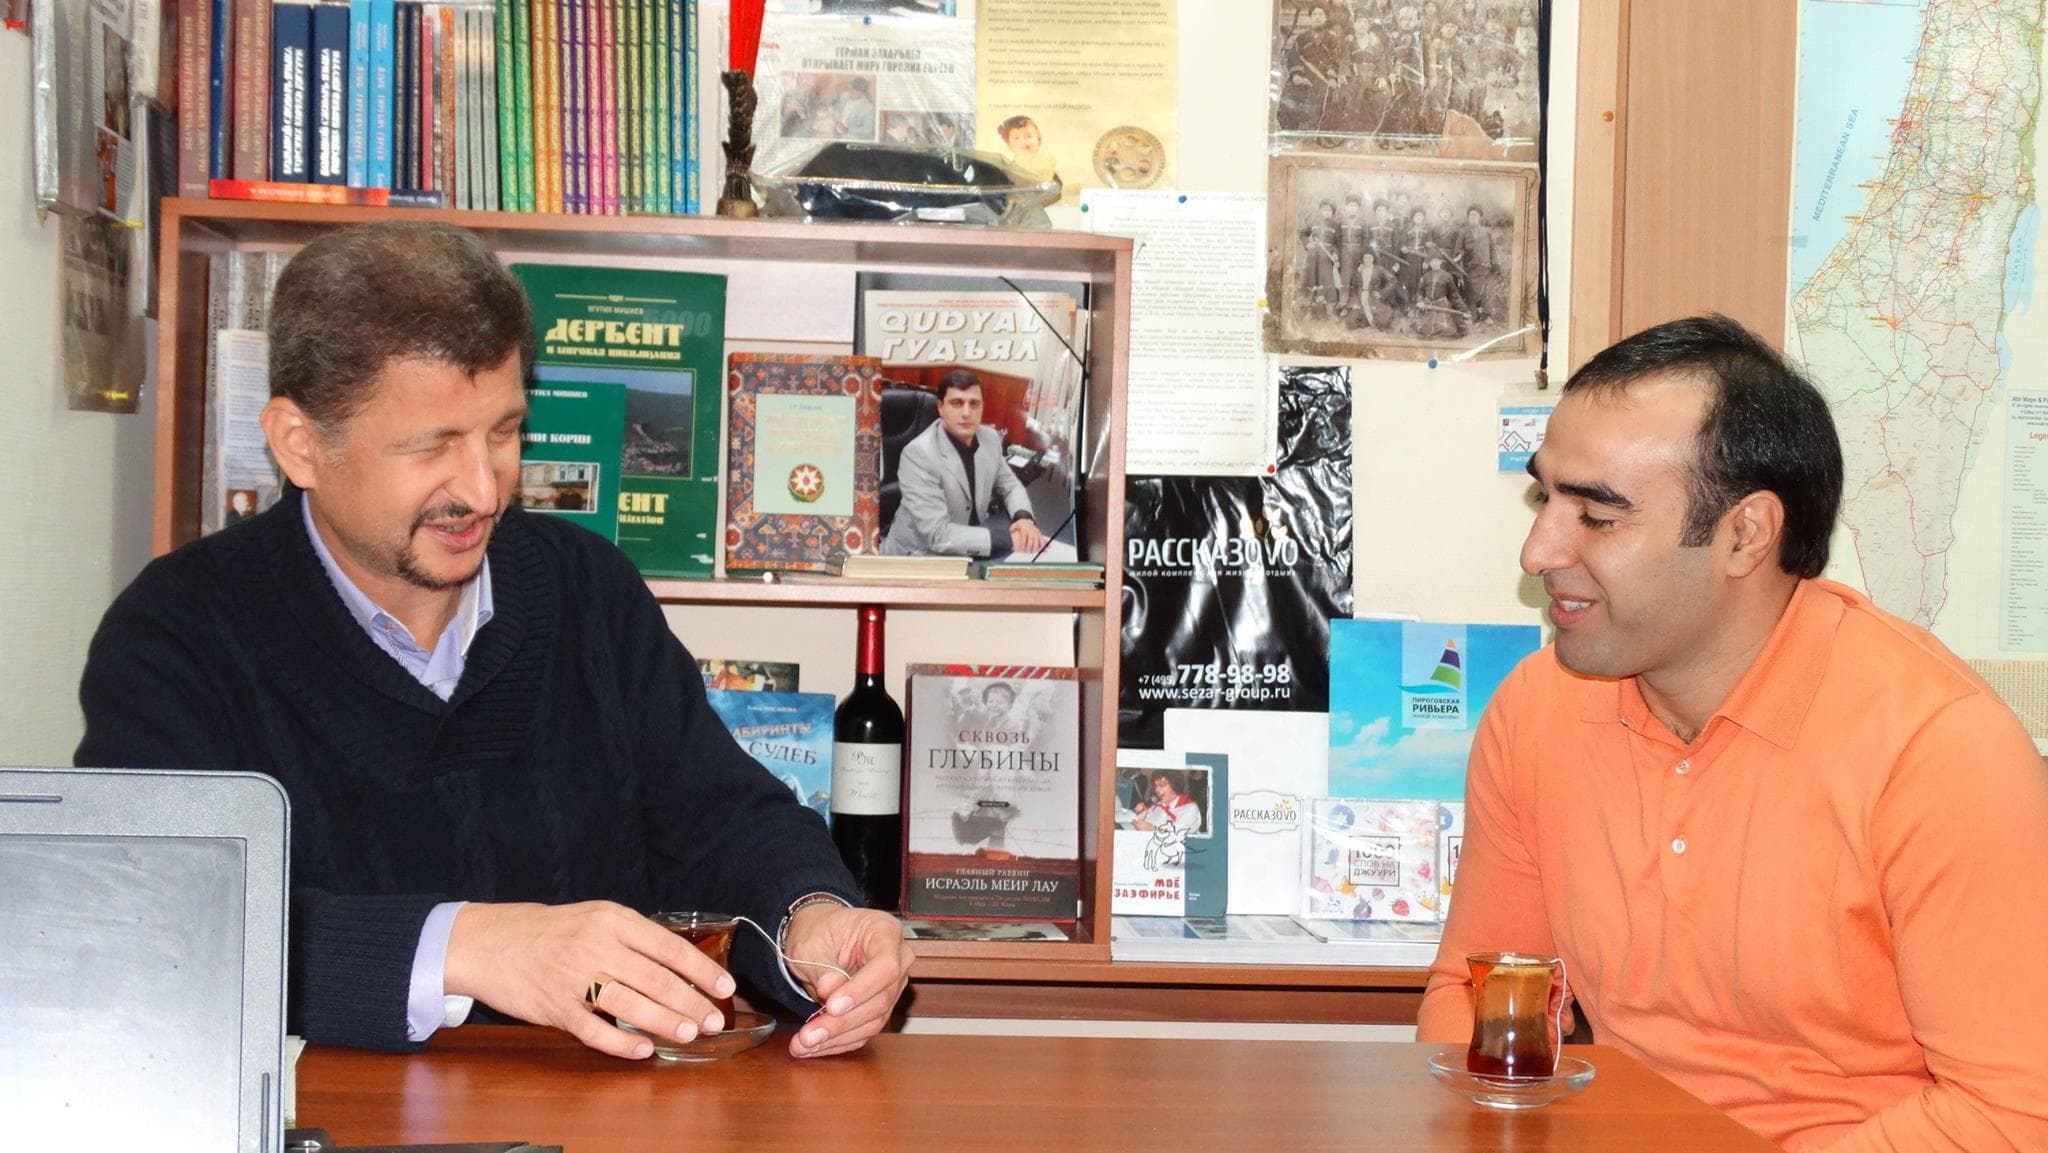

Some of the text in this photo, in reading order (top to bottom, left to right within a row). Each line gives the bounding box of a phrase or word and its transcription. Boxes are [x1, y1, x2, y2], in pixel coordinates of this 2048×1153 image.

[1811, 108, 1859, 222] MEDITERRANEAN SEA
[878, 309, 1041, 335] QUDYAL
[544, 318, 684, 346] ДЕРБЕНТ
[1138, 675, 1150, 684] +7
[1177, 663, 1291, 684] 778-98-98
[1138, 687, 1291, 702] www.sezar-group.ru
[1412, 703, 1460, 714] РИВЬЕРА
[958, 729, 1031, 745] СКВОЗЬ
[748, 740, 817, 765] СУДЕБ
[927, 748, 1060, 772] ГЛУБИНЫ
[1353, 859, 1380, 868] СЛОВ
[956, 868, 1030, 877] ГЛАВНЫЙ РАВВИН
[1353, 868, 1396, 877] ДЖУУРИ
[925, 877, 1059, 893] ИСРАЭЛЬ МЕИР ЛАУ
[1154, 876, 1181, 888] МОЁ
[1114, 888, 1181, 900] ЗАЭФИРЬЕ
